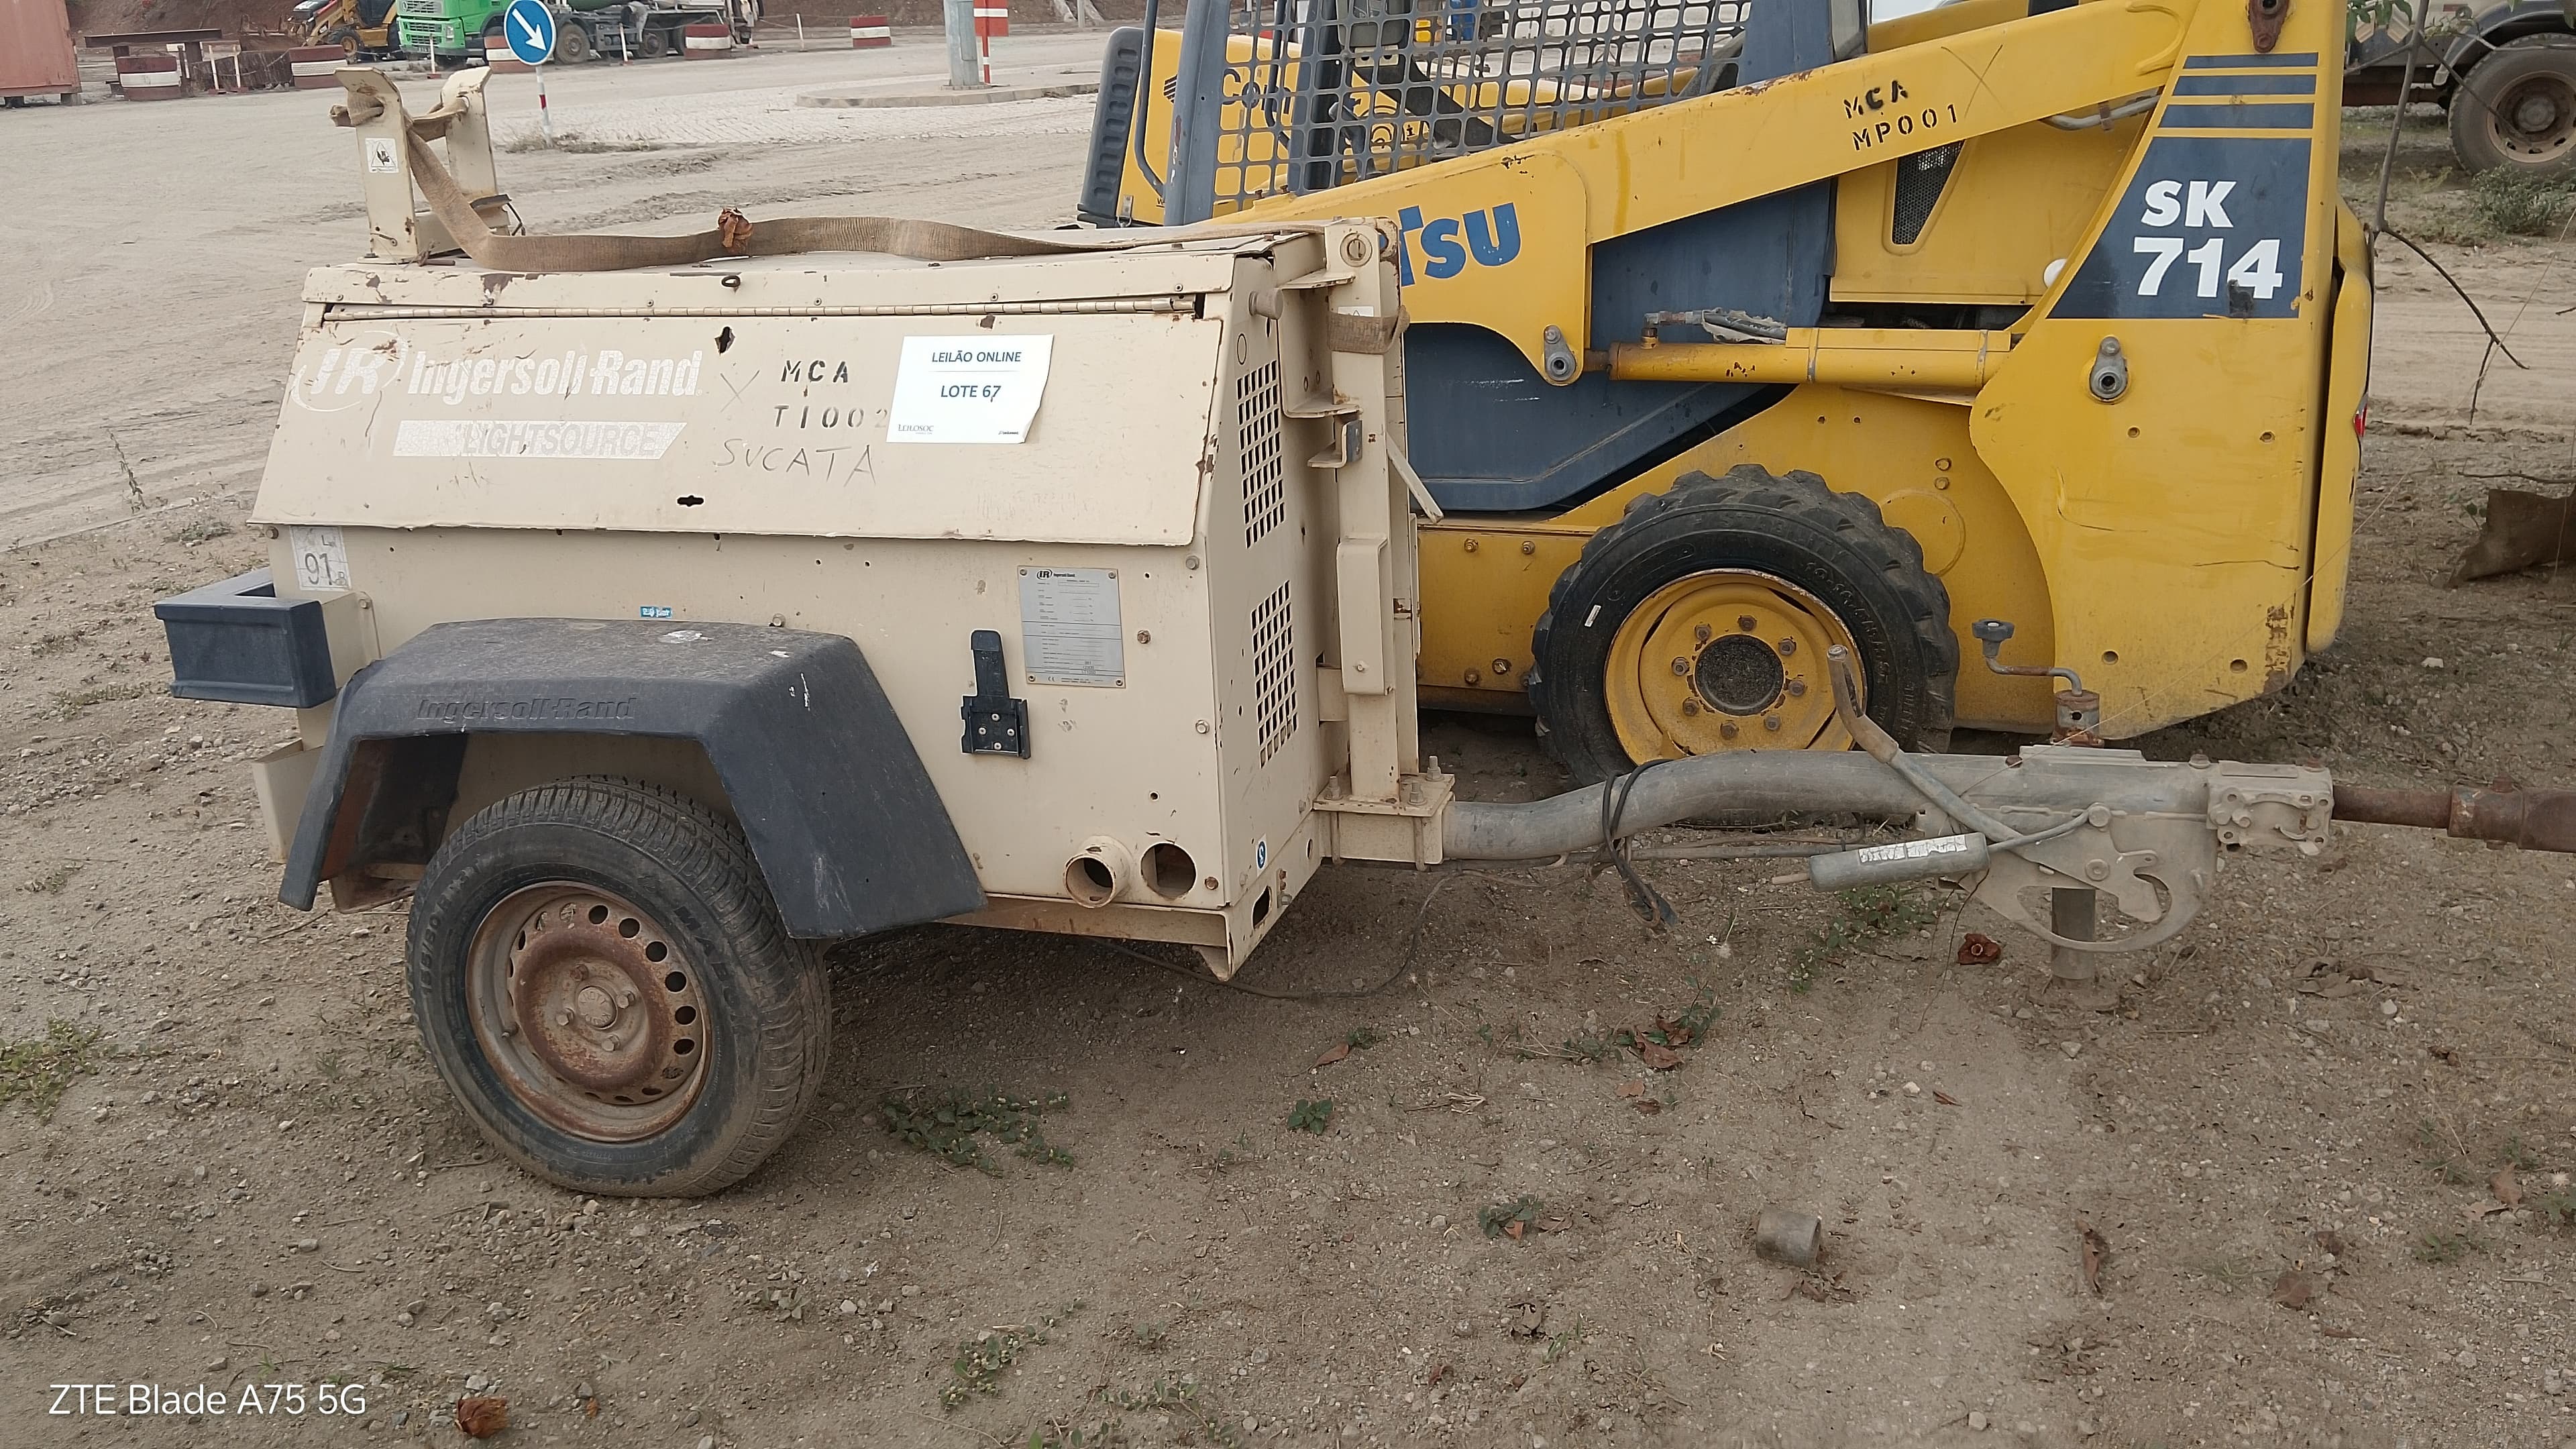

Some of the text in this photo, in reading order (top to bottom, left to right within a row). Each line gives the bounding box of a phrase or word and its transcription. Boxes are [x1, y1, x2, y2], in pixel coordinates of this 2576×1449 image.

[1844, 80, 1908, 119] MCA
[1852, 104, 1957, 151] MP001
[2141, 180, 2237, 227] SK
[1380, 203, 1521, 287] TSU
[2133, 237, 2284, 299] 714
[781, 360, 849, 383] MCA
[932, 350, 1022, 362] LEILÃO ONLINE
[941, 385, 1002, 398] LOTE 67
[462, 423, 661, 456] LIGHTSOURCE
